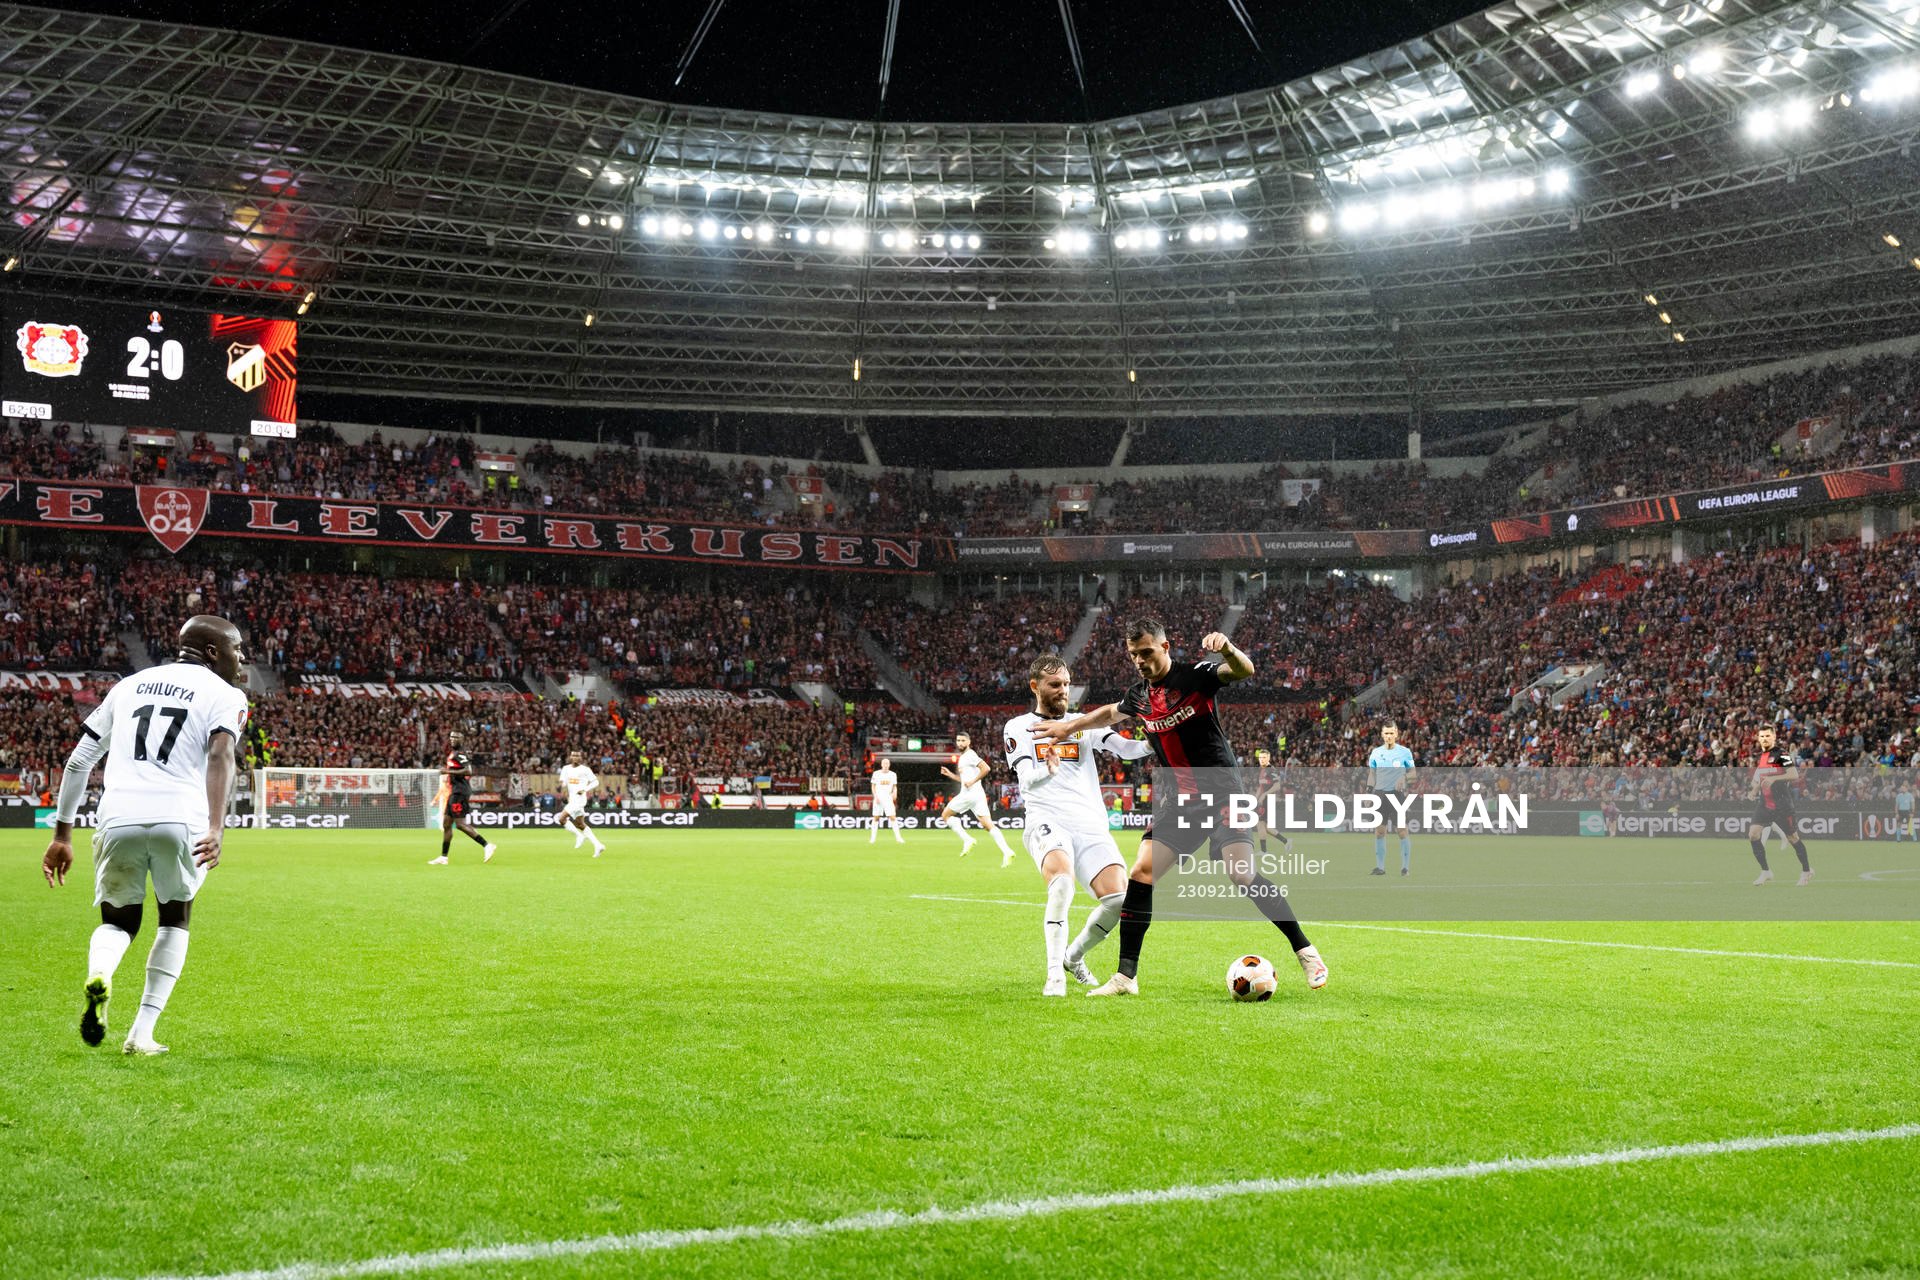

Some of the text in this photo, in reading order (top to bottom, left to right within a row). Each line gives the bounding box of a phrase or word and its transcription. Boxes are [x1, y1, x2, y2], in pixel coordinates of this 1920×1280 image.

[126, 336, 184, 380] 2:0
[1698, 486, 1798, 510] UEFA EUROPA LEAGUE
[150, 514, 194, 534] 04
[247, 500, 922, 567] LEVERKUSEN
[136, 682, 195, 702] CHILUFYA
[1146, 704, 1196, 731] armenia
[132, 704, 188, 765] 17
[225, 812, 350, 828] ent-a-car
